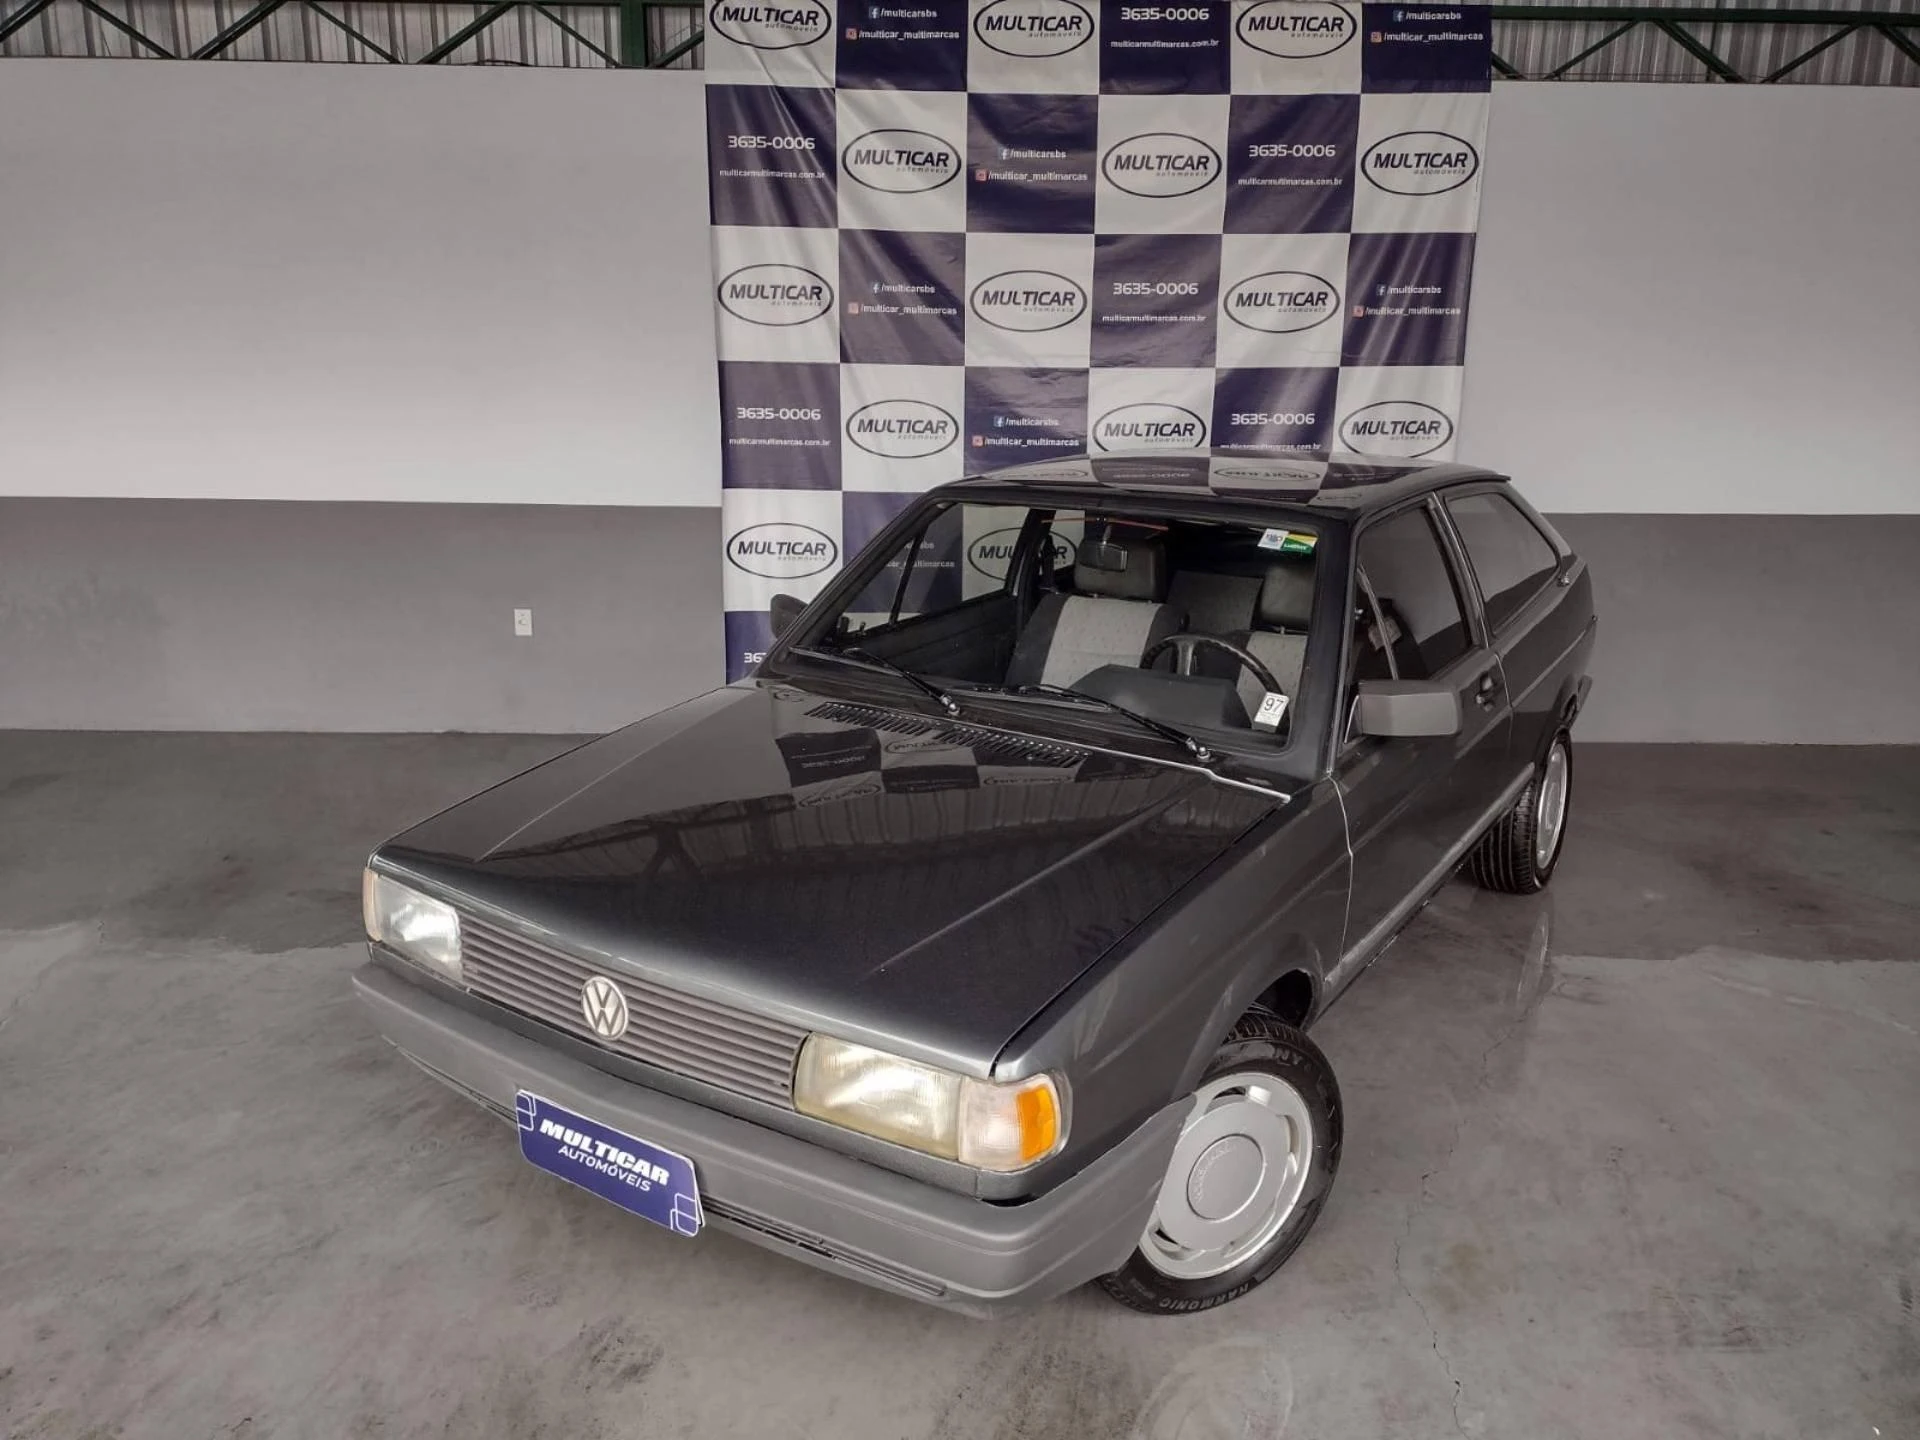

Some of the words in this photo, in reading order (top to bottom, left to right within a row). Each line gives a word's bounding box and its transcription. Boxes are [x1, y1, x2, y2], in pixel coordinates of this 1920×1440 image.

[722, 6, 819, 27] MULTICAR
[1120, 7, 1210, 21] 3635-0006
[985, 15, 1082, 31] MULTICAR
[1248, 16, 1344, 32] MULTICAR
[1110, 38, 1219, 49] multicarmultimarcas.com.br
[728, 135, 815, 150] 3635-0006
[1249, 144, 1336, 157] 3635-0006
[854, 150, 949, 167] MULTICAR
[1114, 154, 1210, 170] MULTICAR
[1374, 152, 1468, 168] MULTICAR
[719, 168, 825, 179] multicarmultimarcas.com.br
[1237, 177, 1344, 186] multicarmultimarcas.com.br
[730, 284, 822, 300] MULTICAR
[1112, 282, 1199, 295] 3635-0006
[981, 290, 1076, 306] MULTICAR
[1235, 291, 1329, 308] MULTICAR
[1102, 313, 1206, 323] multicarmultimarcas.com.br
[736, 407, 821, 420] 3635-0006
[1231, 413, 1316, 425] 3635-0006
[857, 419, 949, 435] MULTICAR
[1104, 422, 1196, 436] MULTICAR
[1351, 420, 1442, 435] MULTICAR
[728, 437, 831, 447] multicarmultimarcas.com.br
[738, 541, 827, 556] MULTICAR
[1264, 697, 1284, 712] 97
[540, 1118, 670, 1185] MULTICAR
[558, 1144, 651, 1192] AUTOMÓVEIS
